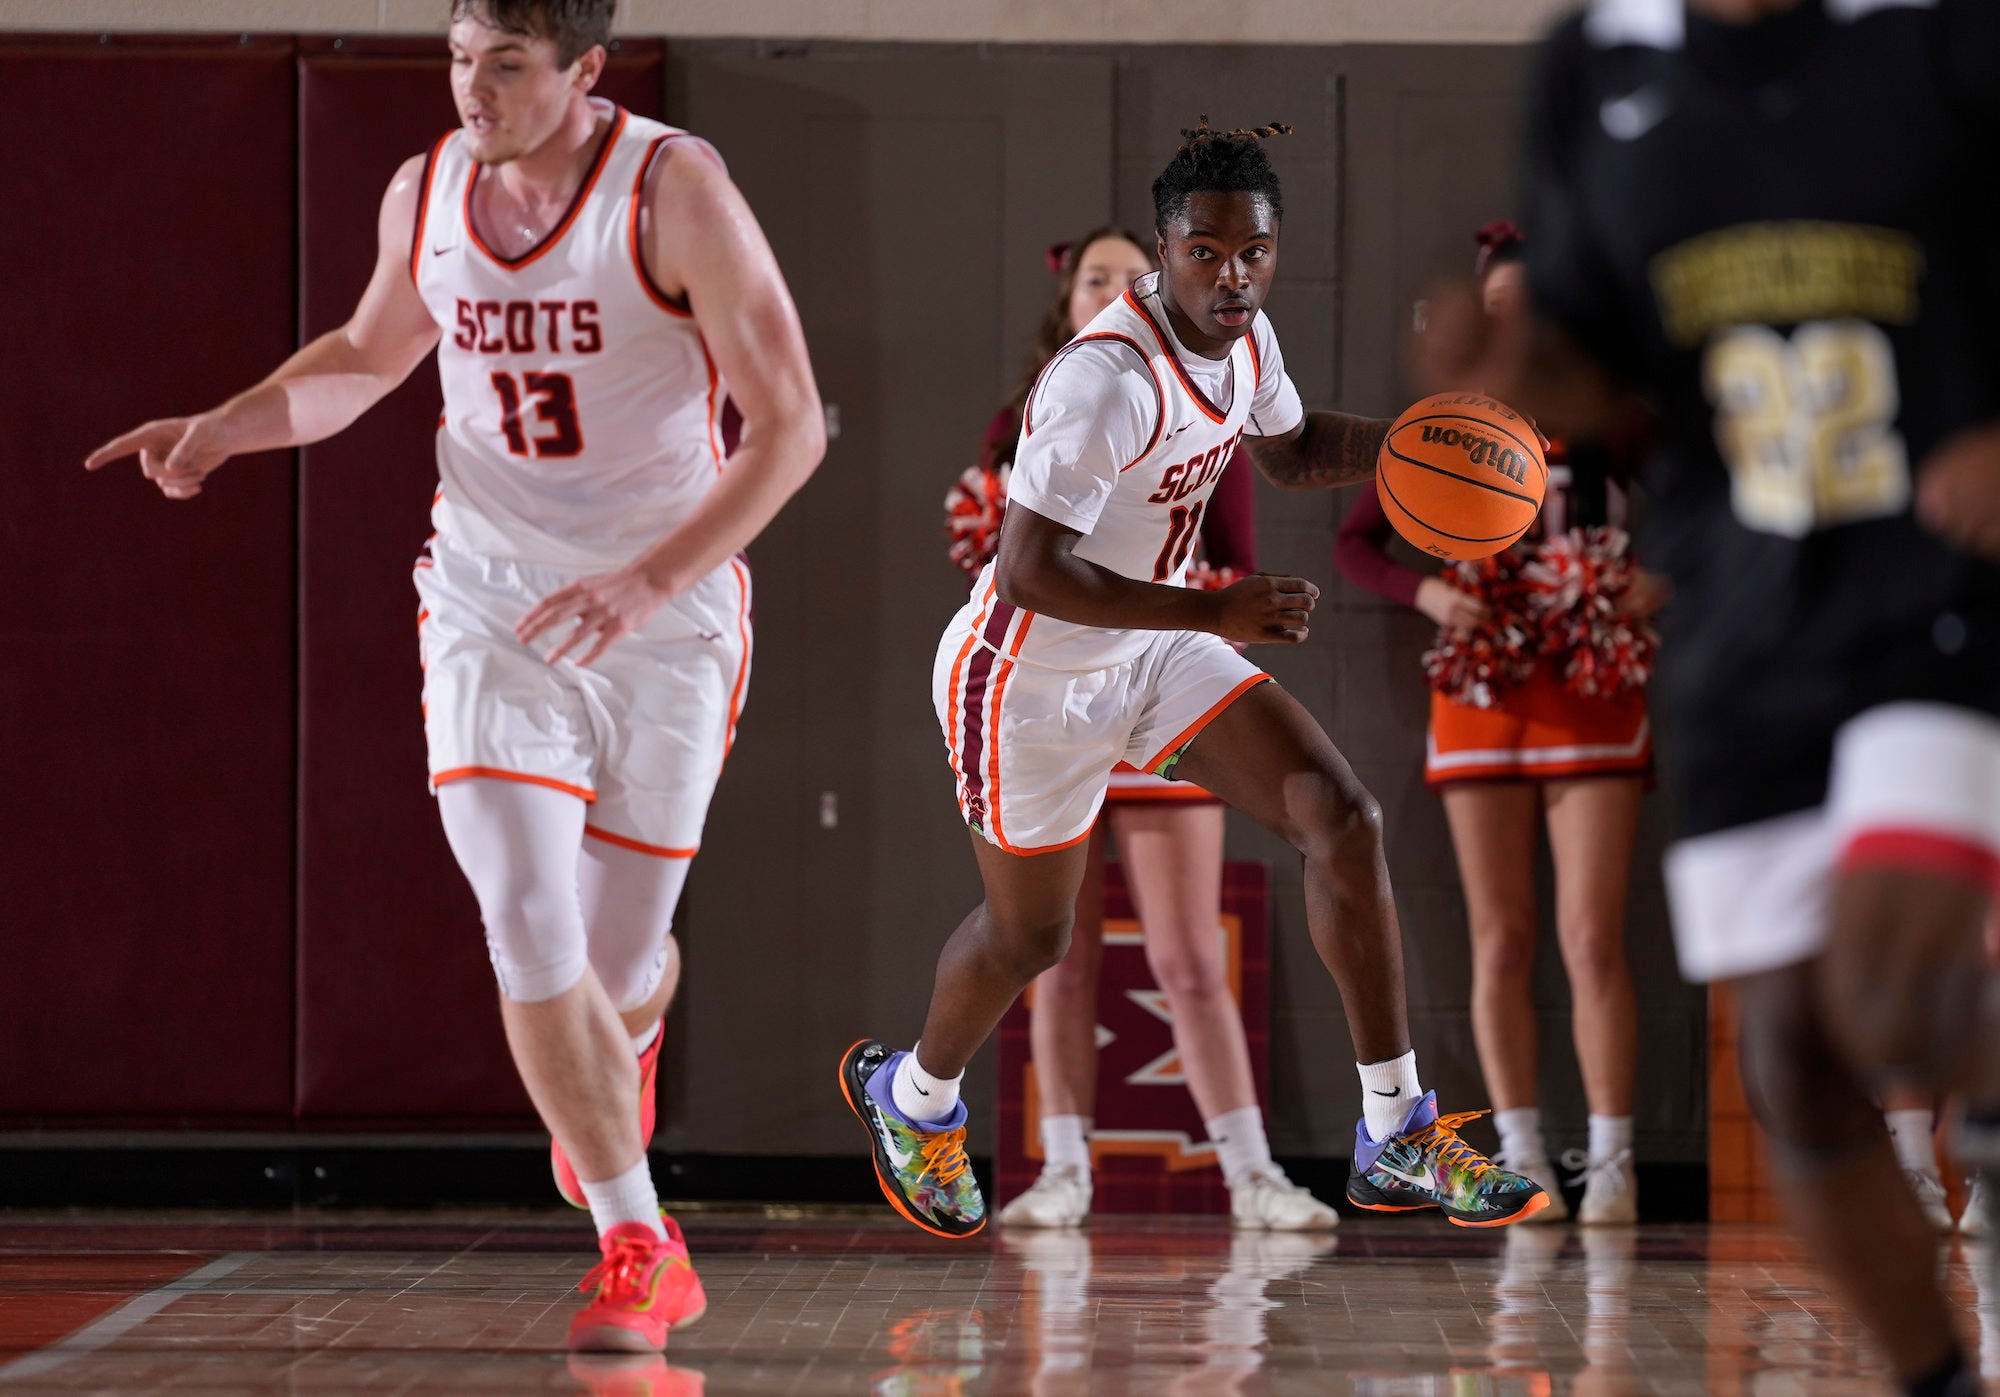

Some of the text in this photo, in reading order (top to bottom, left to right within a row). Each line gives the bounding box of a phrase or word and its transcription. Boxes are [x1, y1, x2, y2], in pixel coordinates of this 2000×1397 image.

[454, 296, 603, 355] SCOTS
[490, 371, 584, 458] 13
[1422, 425, 1527, 487] Wilson
[1151, 499, 1204, 583] 11
